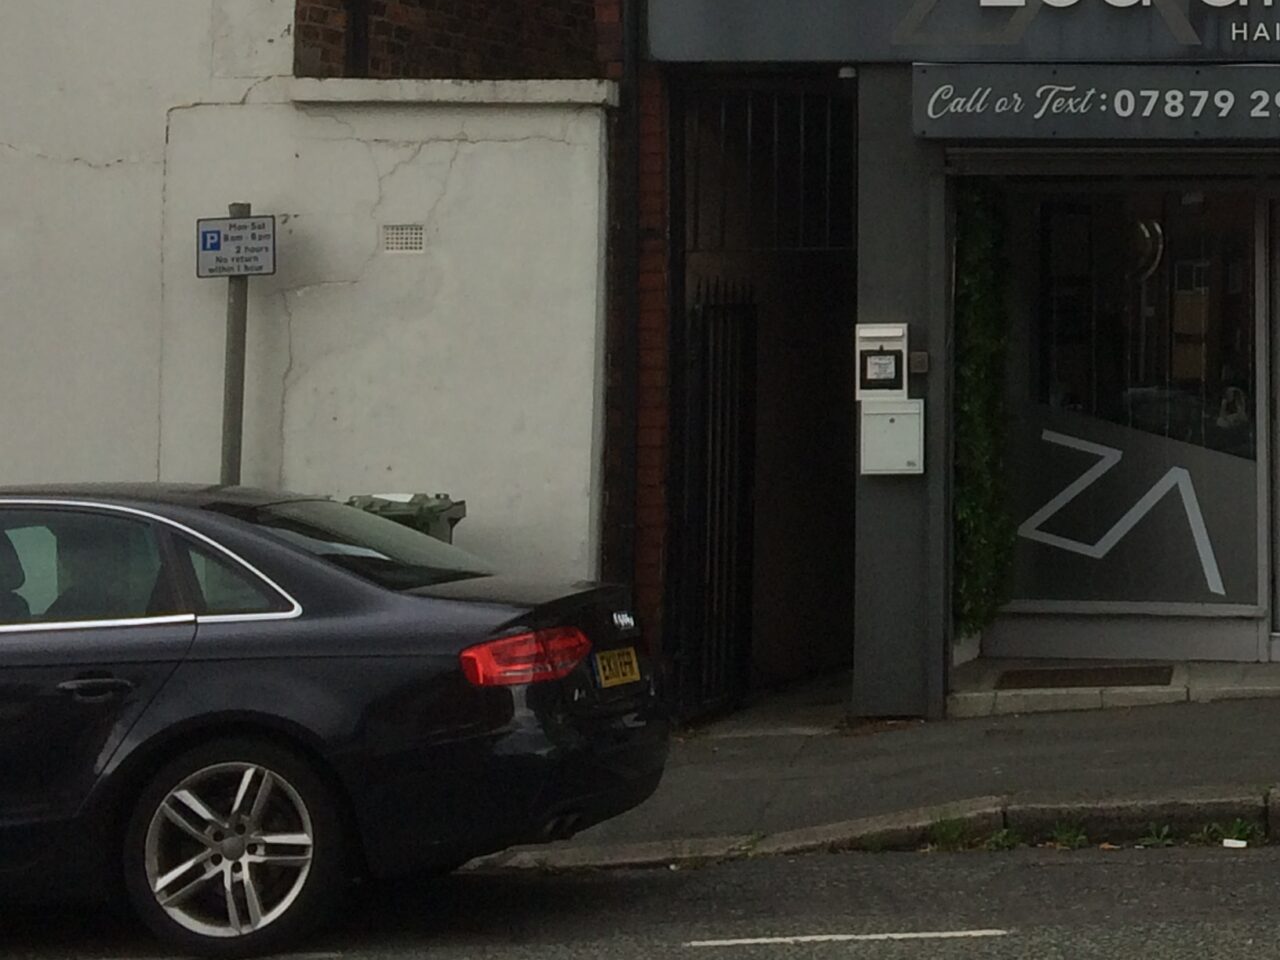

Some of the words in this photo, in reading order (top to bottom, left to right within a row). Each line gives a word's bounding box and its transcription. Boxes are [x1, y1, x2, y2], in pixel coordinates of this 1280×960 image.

[927, 84, 993, 120] Call
[994, 92, 1025, 114] or
[1113, 89, 1236, 118] 07879
[206, 233, 219, 250] P
[235, 245, 241, 254] 2
[244, 245, 269, 253] hours
[215, 255, 229, 264] No
[231, 255, 259, 264] return
[208, 265, 235, 274] within
[244, 264, 264, 272] hour
[1016, 428, 1227, 596] ZA
